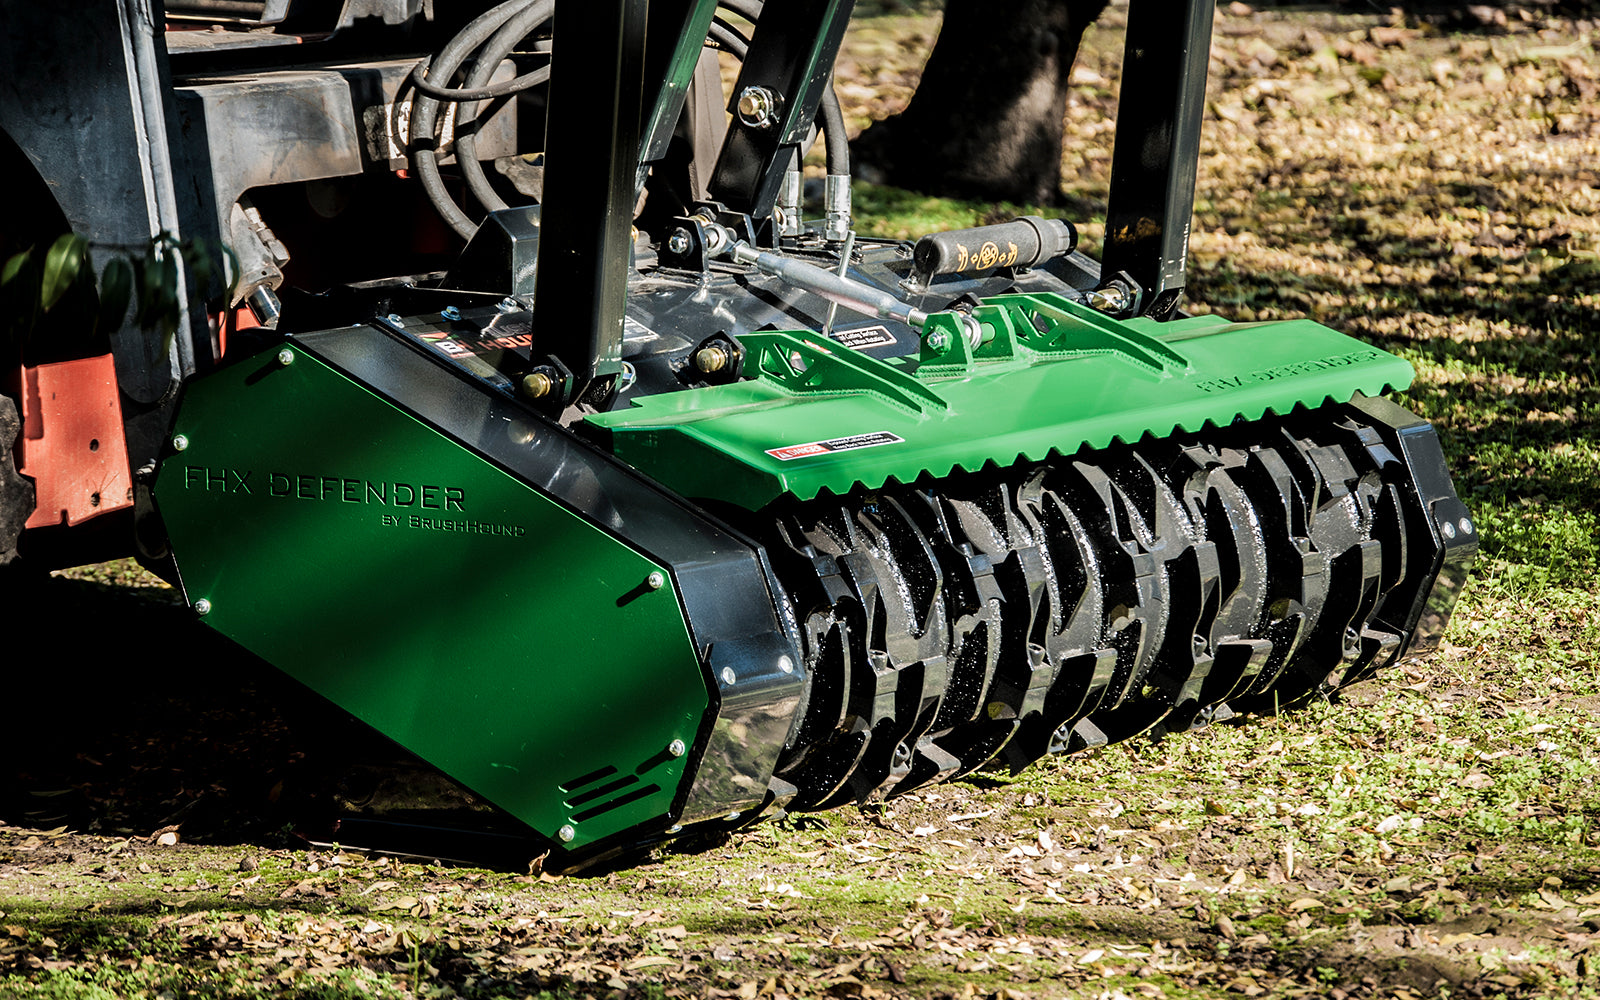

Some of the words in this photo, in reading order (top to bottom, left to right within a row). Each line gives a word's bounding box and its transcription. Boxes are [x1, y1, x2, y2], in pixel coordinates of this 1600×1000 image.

[477, 333, 533, 351] HOU
[184, 466, 254, 495] FHX
[269, 473, 465, 512] DEFENDER
